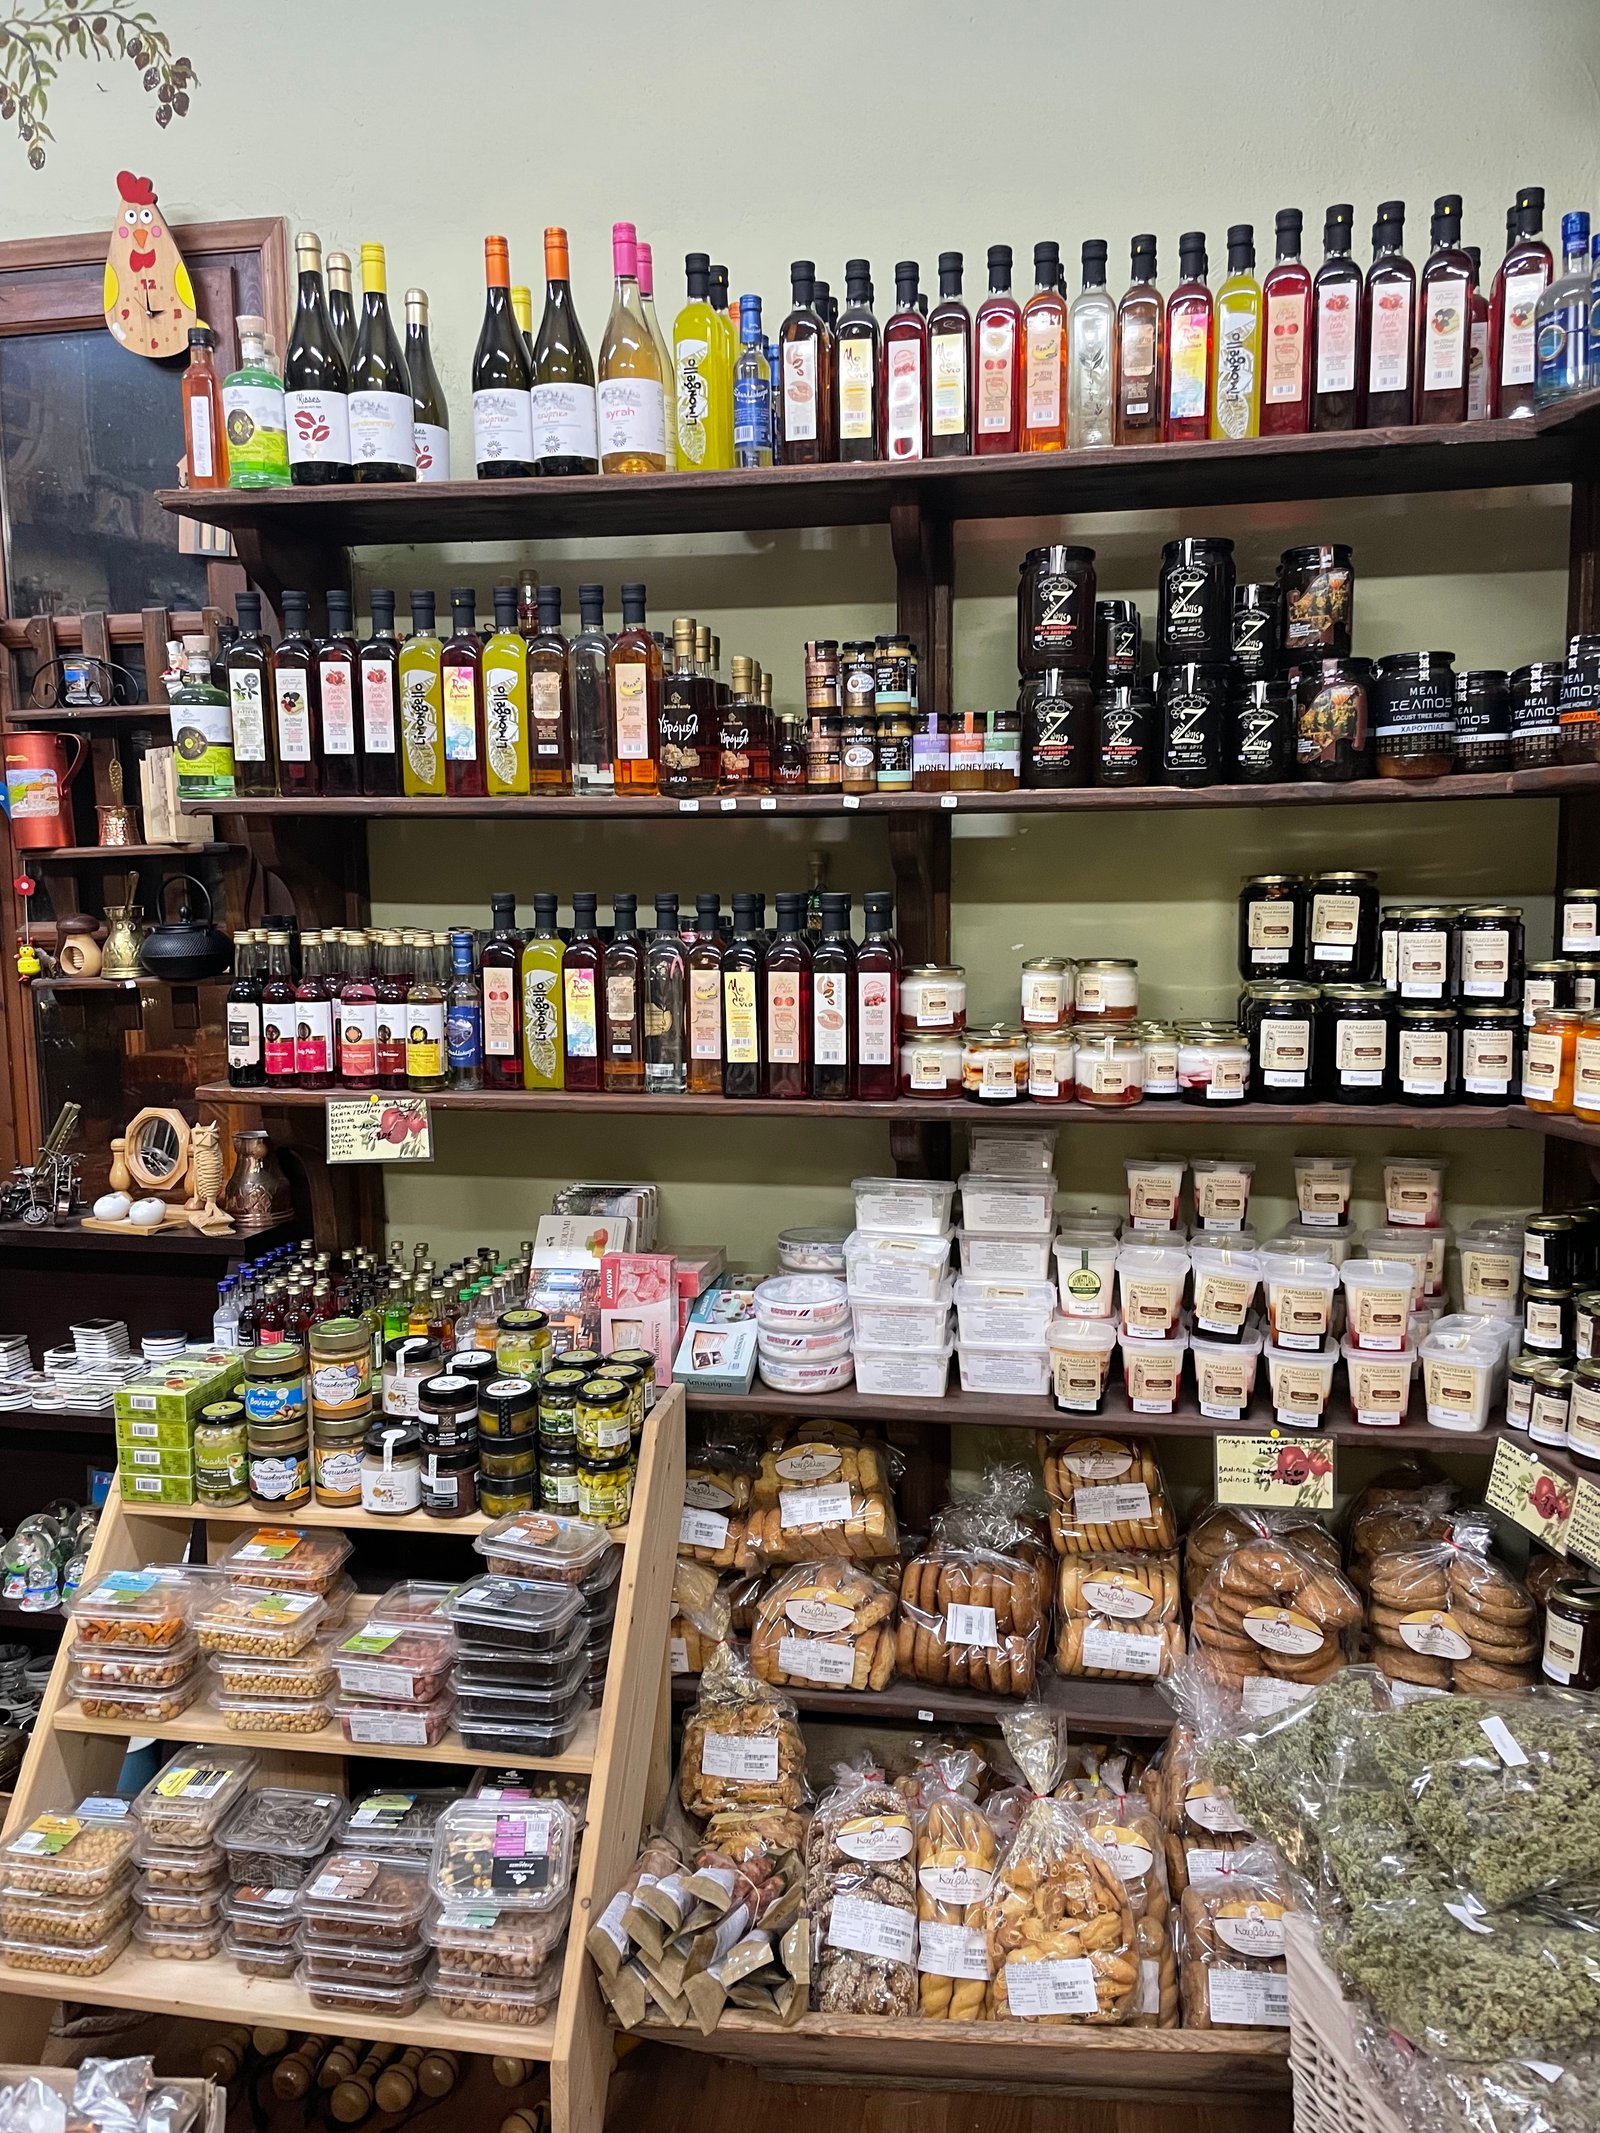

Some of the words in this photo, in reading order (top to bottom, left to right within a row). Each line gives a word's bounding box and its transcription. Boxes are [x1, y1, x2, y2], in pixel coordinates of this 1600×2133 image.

[141, 279, 156, 290] 12
[121, 309, 130, 320] 9
[606, 407, 635, 420] syrah
[1409, 686, 1438, 697] ΜΕΛΙ
[1524, 697, 1548, 707] ΜΕΛΙ
[1393, 713, 1416, 721] LOCUST
[658, 713, 699, 741] Υδρόμελι
[1400, 723, 1445, 733] ΧΑΡΟΥΠΙΑΣ
[919, 763, 947, 772] HONEY
[954, 763, 982, 771] HONEY
[984, 762, 1004, 770] ONEY
